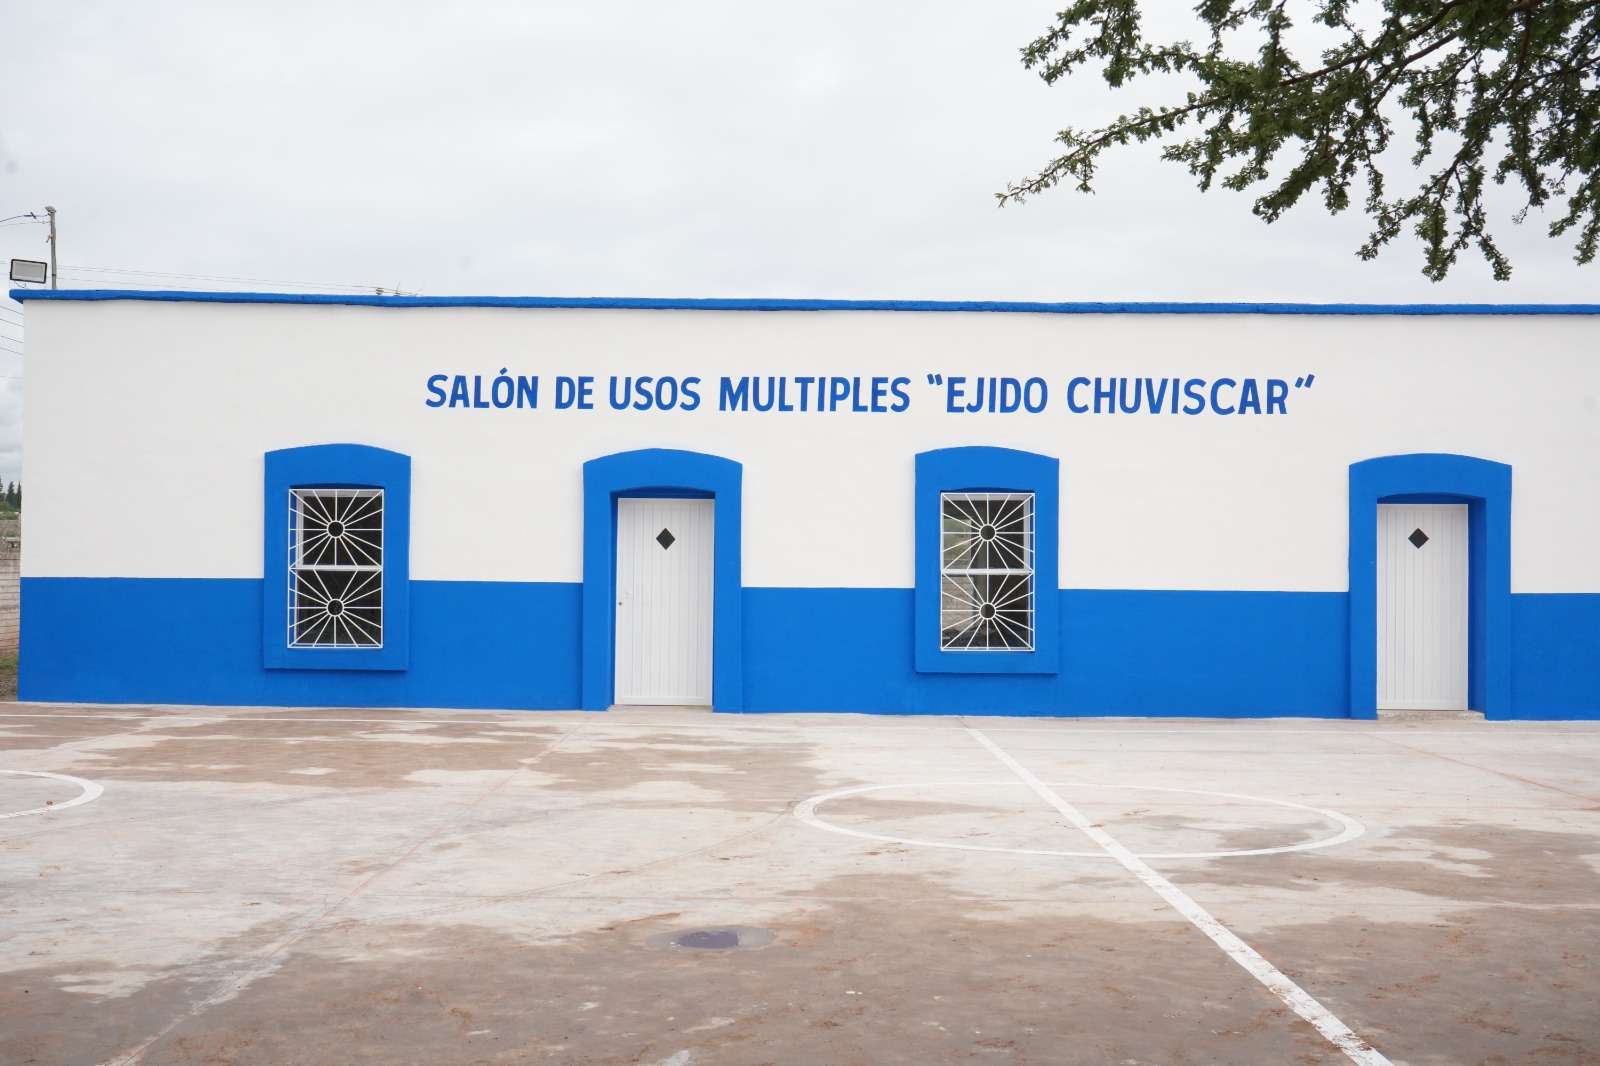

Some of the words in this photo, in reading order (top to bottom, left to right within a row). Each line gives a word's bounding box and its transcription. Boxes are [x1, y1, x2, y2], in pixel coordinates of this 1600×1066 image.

[426, 367, 539, 410] SALÓN
[554, 375, 594, 411] DE
[609, 375, 702, 412] USOS
[719, 375, 911, 414] MULTIPLES
[926, 373, 1049, 414] "EJIDO
[1066, 374, 1315, 416] CHUVISCAR"
